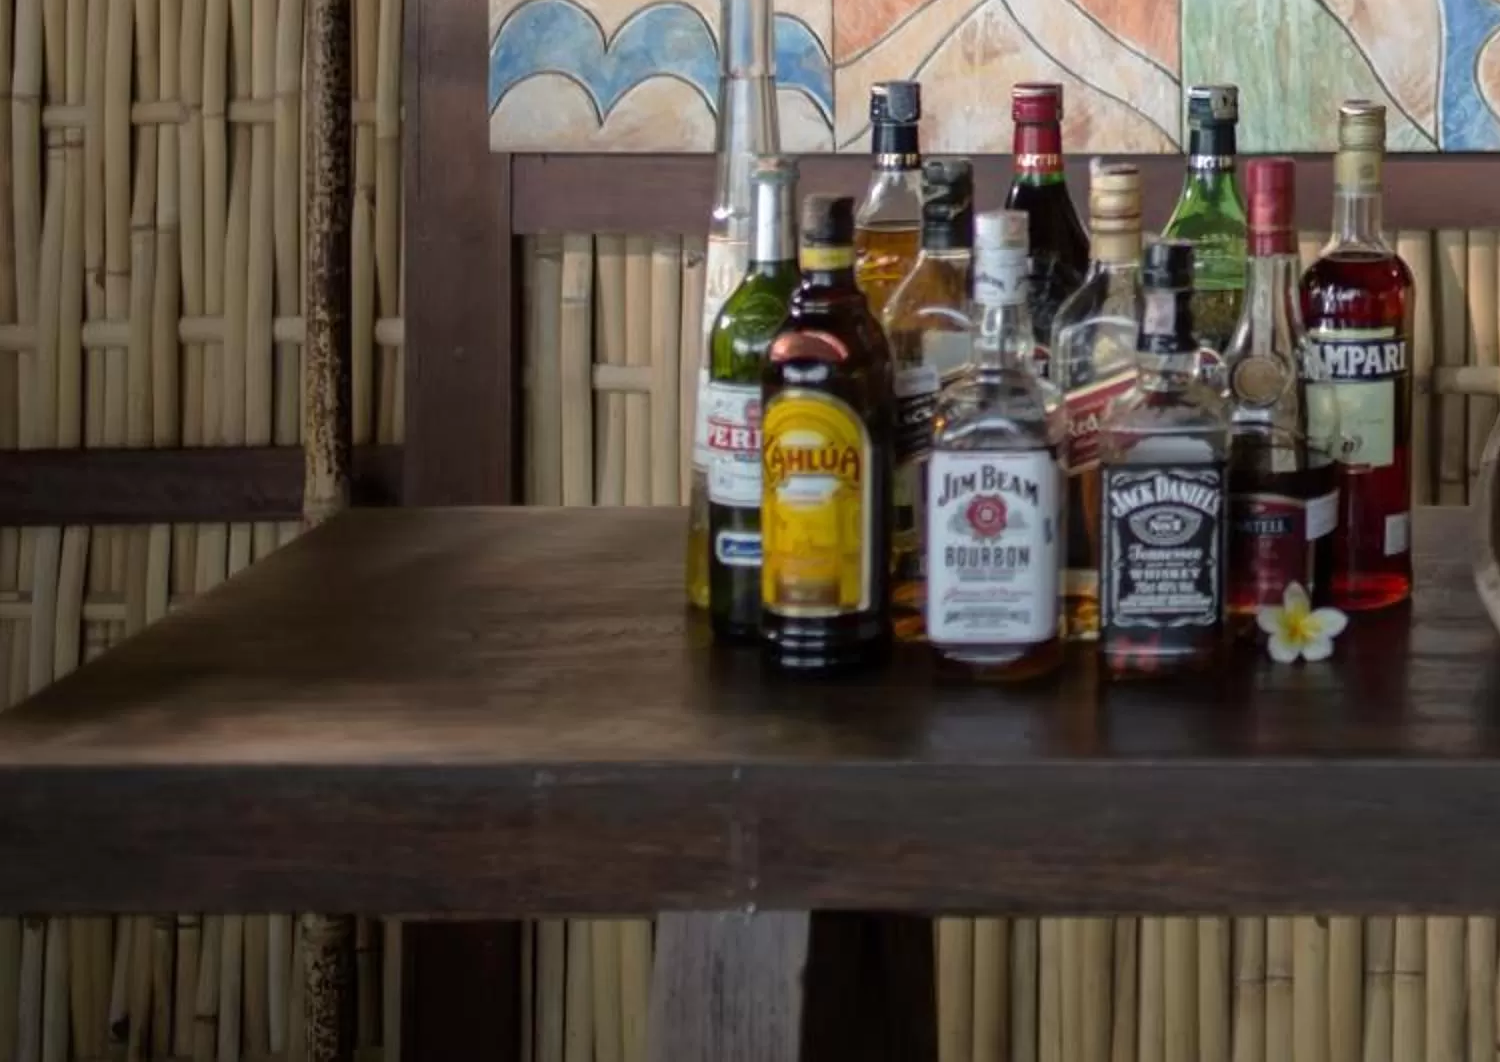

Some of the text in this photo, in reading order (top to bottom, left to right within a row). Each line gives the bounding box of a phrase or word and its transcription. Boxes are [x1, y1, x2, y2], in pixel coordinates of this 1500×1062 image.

[938, 463, 1039, 507] JIM BEAM
[1111, 482, 1155, 518] JACK
[945, 546, 1030, 567] BOURBON
